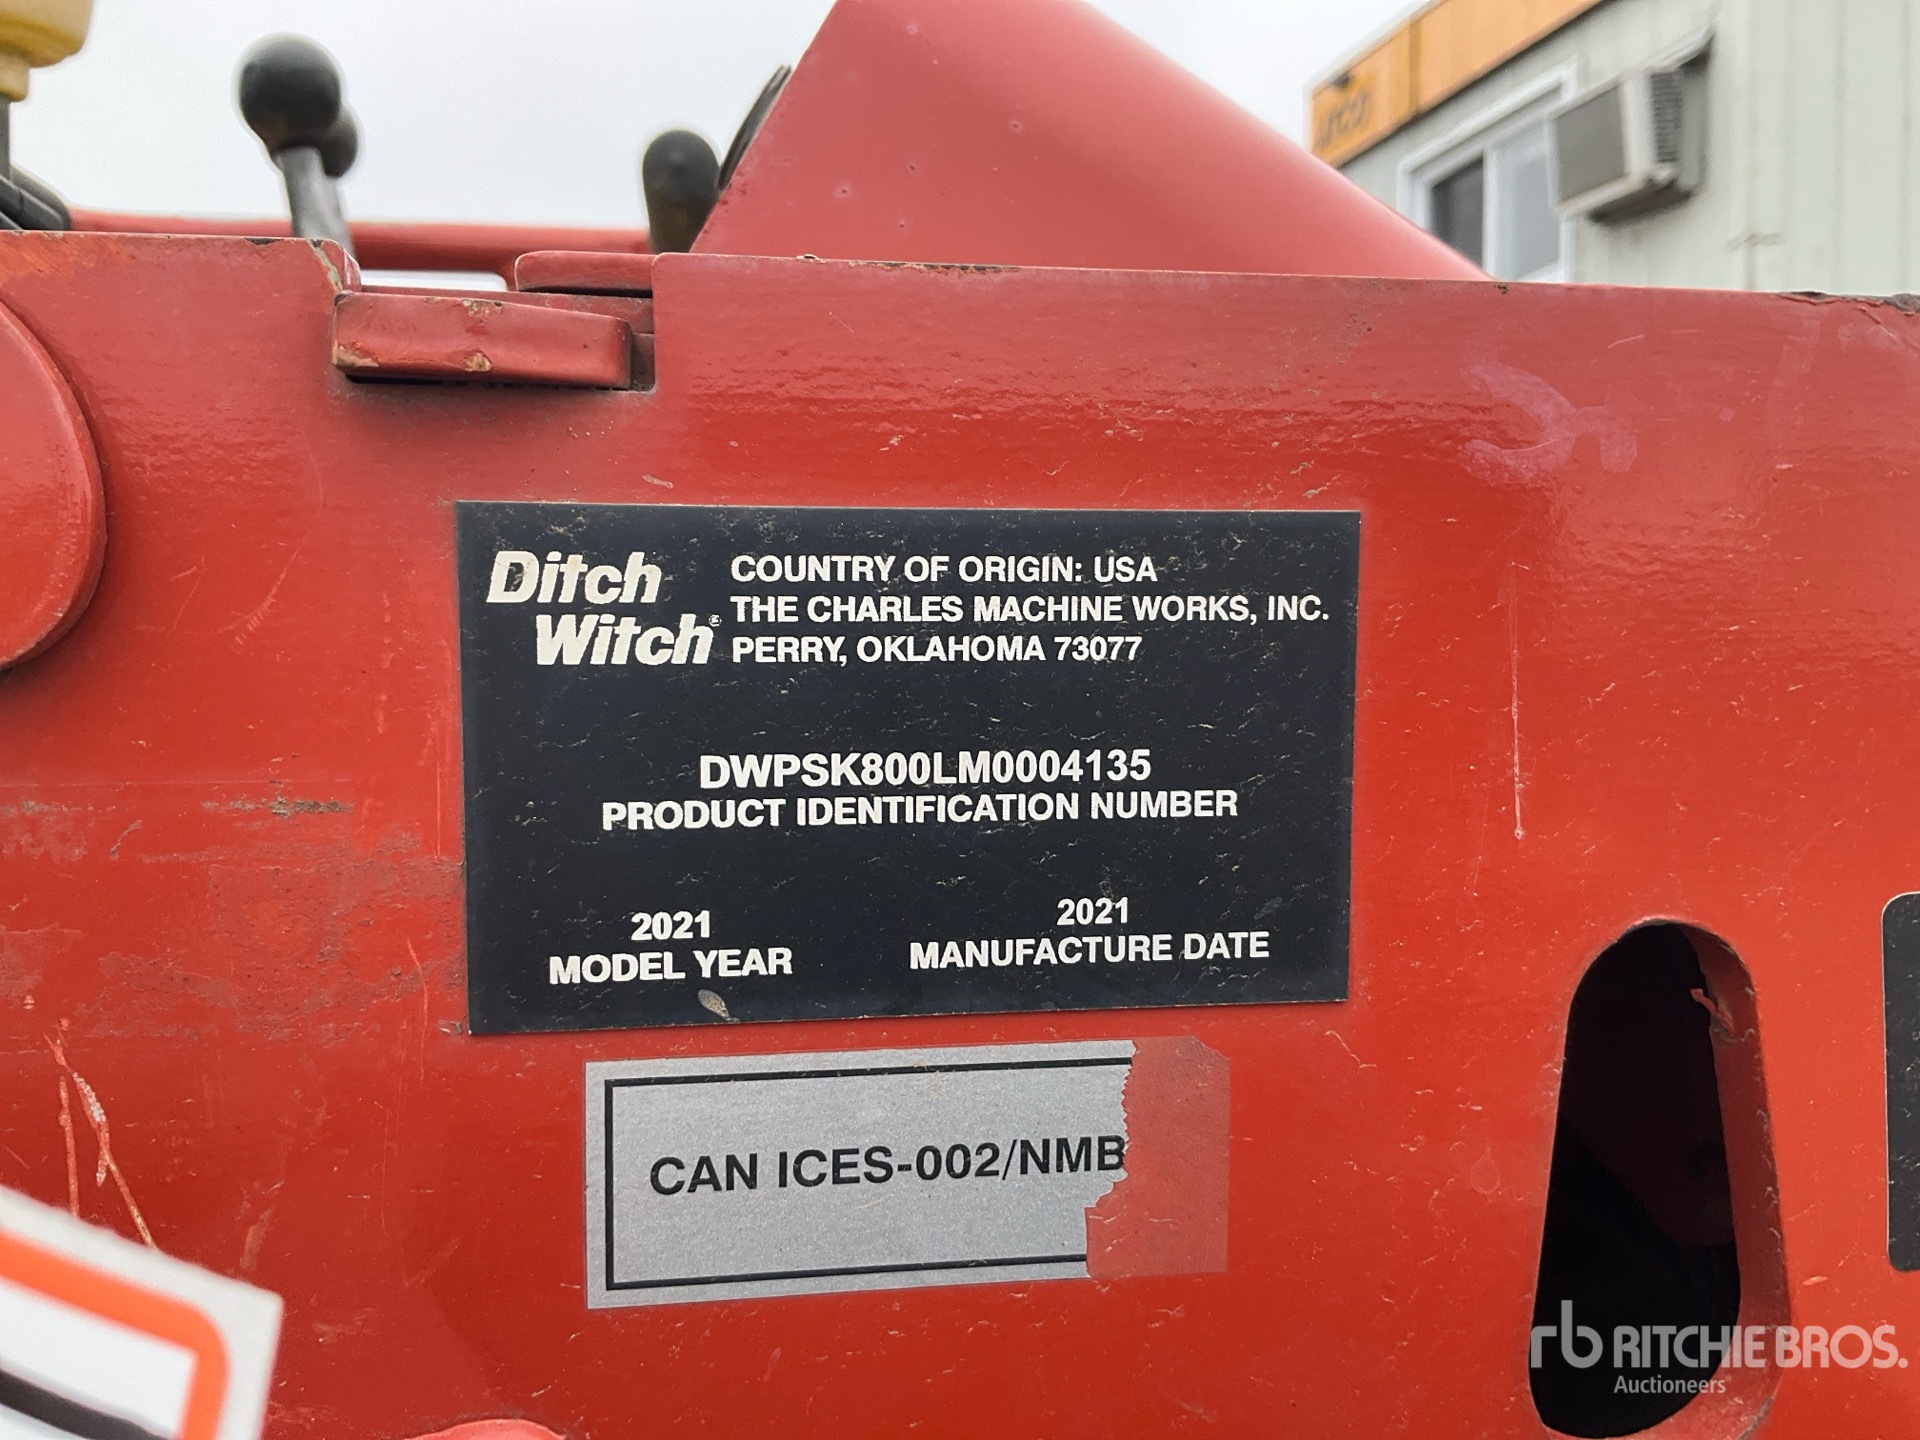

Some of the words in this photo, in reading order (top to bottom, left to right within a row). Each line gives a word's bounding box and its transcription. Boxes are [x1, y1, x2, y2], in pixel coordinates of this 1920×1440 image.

[485, 550, 662, 604] Ditch
[730, 555, 896, 582] COUNTRY
[904, 555, 949, 582] OF
[958, 555, 1083, 582] ORIGIN:
[1094, 556, 1158, 582] USA
[730, 595, 798, 623] THE
[807, 595, 964, 623] CHARLES
[973, 595, 1123, 622] MACHINE
[1132, 594, 1257, 625] WORKS,
[1267, 594, 1330, 621] INC.
[732, 635, 848, 666] PERRY,
[856, 635, 1046, 662] OKLAHOMA
[1054, 635, 1142, 661] 73077
[700, 749, 1151, 788] DWPSK800LM0004135
[602, 798, 787, 831] PRODUCT
[797, 792, 1079, 826] IDENTIFICATION
[1091, 789, 1238, 819] NUMBER
[630, 910, 711, 941] 2021
[1057, 897, 1129, 925] 2021
[549, 951, 686, 984] MODEL
[693, 947, 793, 978] YEAR
[909, 933, 1173, 969] MANUFACTURE
[1184, 931, 1270, 959] DATE
[650, 1153, 758, 1195] CAN
[778, 1135, 1126, 1188] ICES-002/NMB
